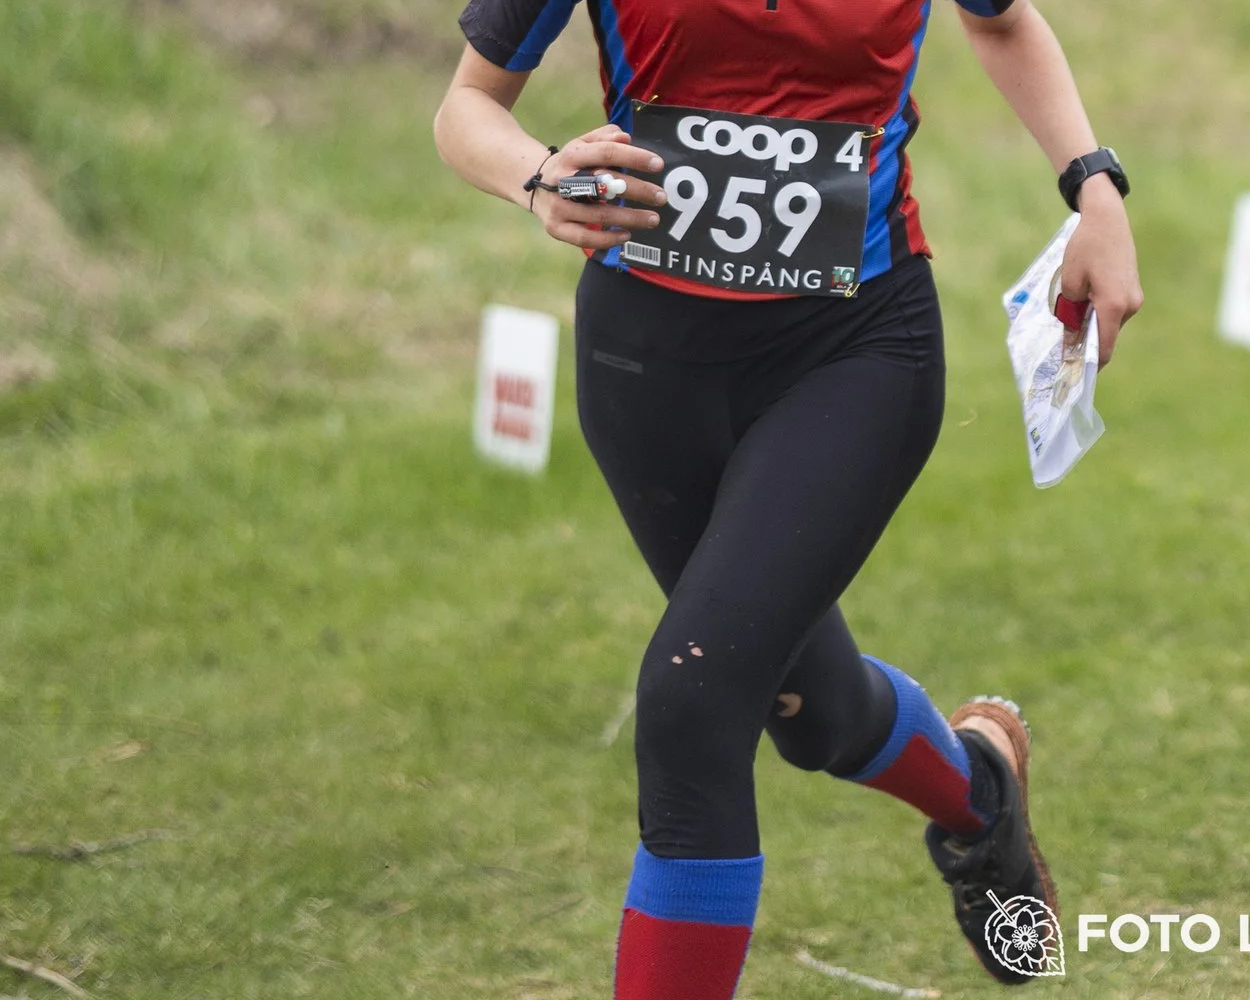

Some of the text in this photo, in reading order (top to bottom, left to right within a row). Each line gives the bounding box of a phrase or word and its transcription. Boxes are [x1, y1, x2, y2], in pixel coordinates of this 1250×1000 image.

[677, 115, 864, 173] coop 4
[663, 165, 822, 258] 959
[667, 250, 822, 290] FINSPÅNG
